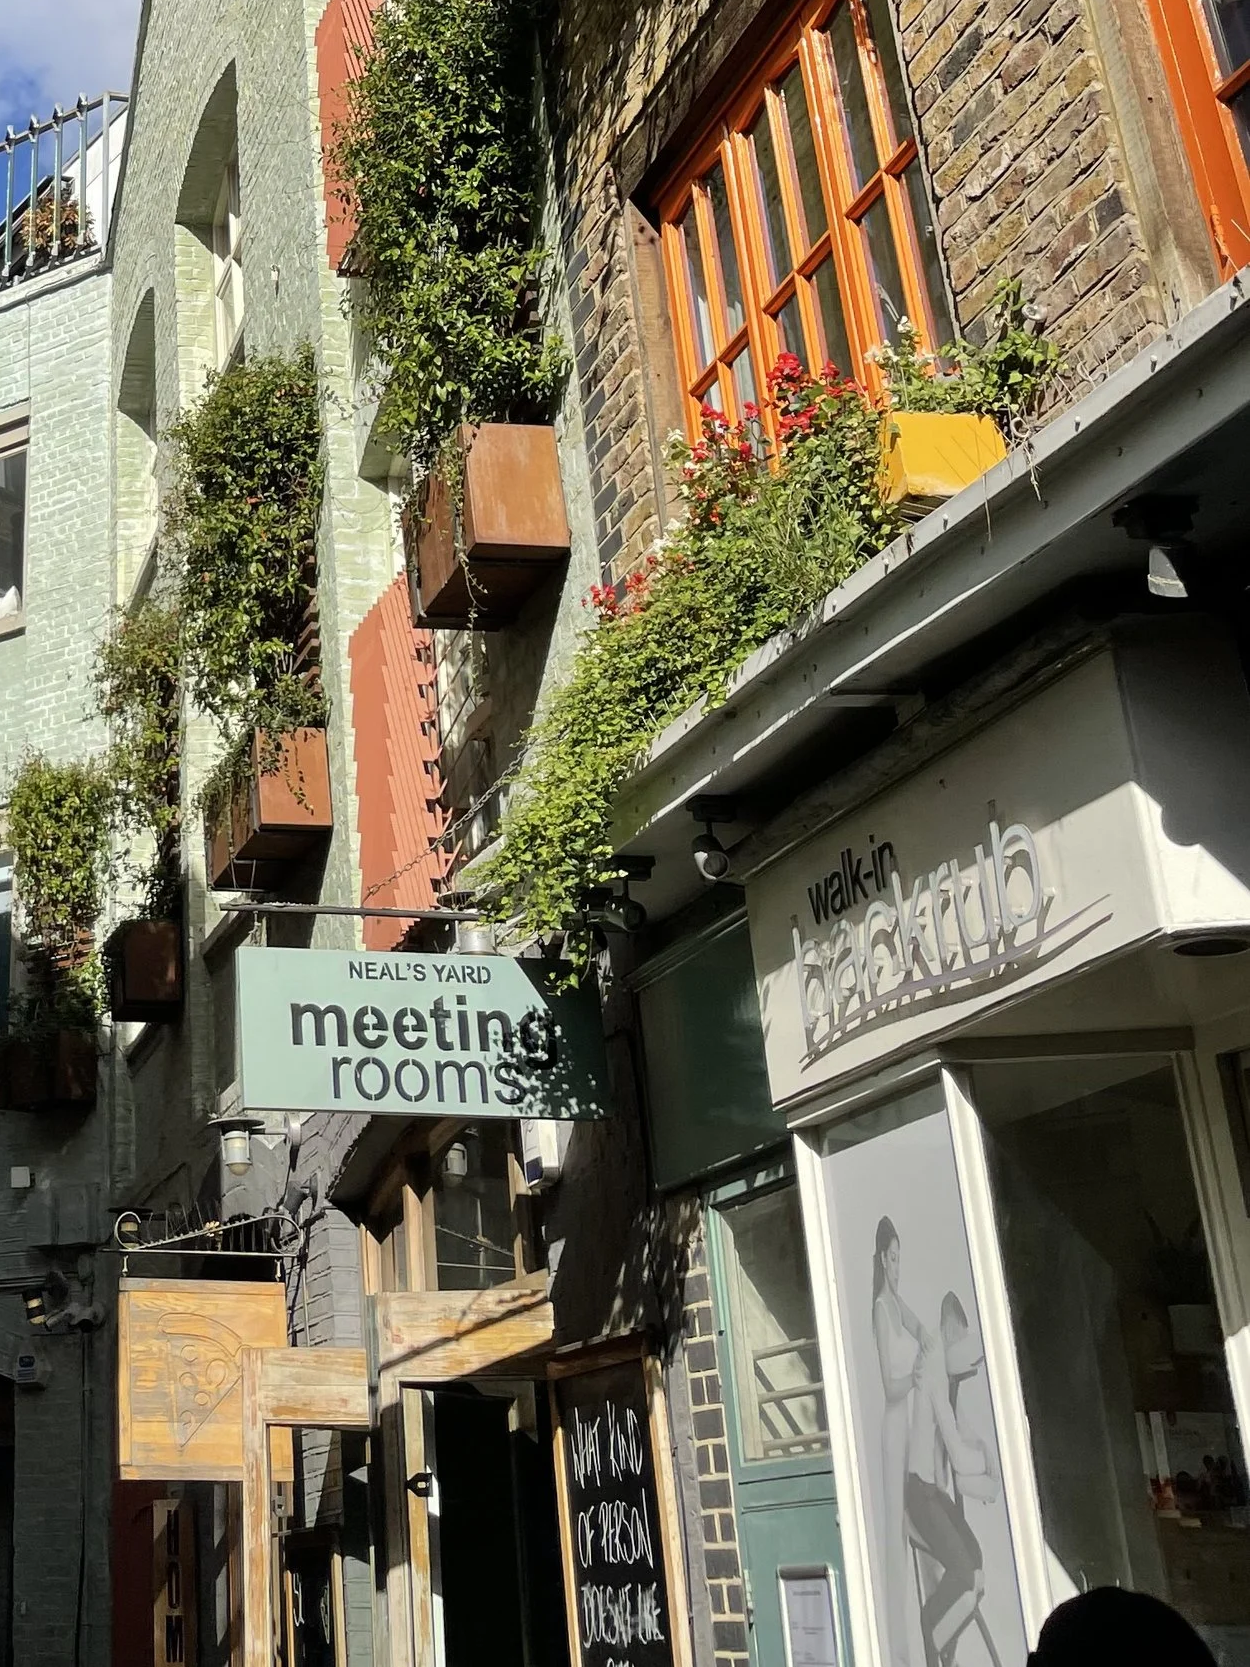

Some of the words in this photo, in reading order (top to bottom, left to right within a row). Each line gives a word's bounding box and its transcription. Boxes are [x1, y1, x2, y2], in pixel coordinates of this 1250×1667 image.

[807, 834, 895, 925] walk-in
[791, 818, 1043, 1030] backrub
[349, 960, 427, 982] NEAL'S
[432, 964, 492, 984] YARD
[290, 994, 558, 1070] meeting
[331, 1056, 527, 1105] rooms
[571, 1407, 601, 1489] WHAT
[607, 1400, 643, 1482] KIND
[578, 1505, 595, 1568] OF
[598, 1487, 654, 1569] PERSON
[638, 1581, 665, 1646] LIKE
